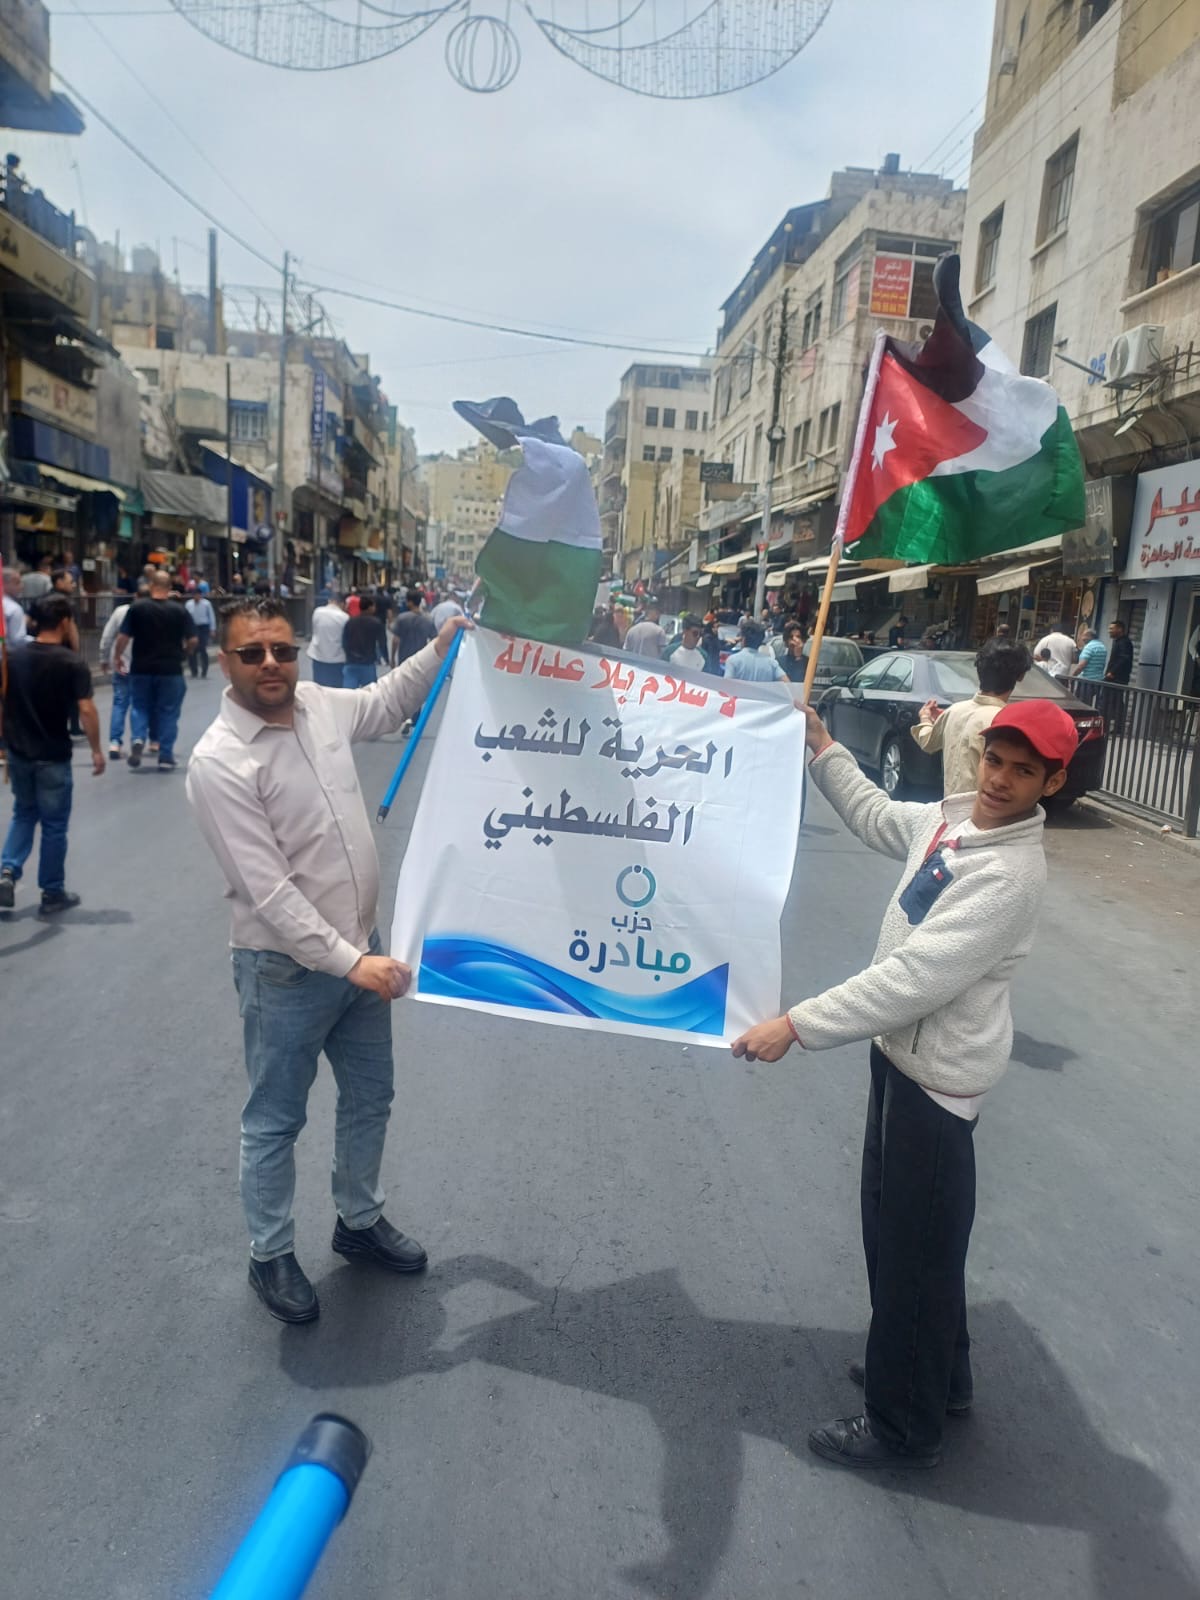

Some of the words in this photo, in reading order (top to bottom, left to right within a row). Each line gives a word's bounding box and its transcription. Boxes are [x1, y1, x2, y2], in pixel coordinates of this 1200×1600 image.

[493, 634, 586, 682] عدالة
[590, 658, 635, 705] بلا
[638, 675, 709, 707] سلام
[474, 707, 592, 763] للشعب
[599, 716, 733, 779] الحرية
[483, 787, 694, 850] الفلسطيني
[611, 911, 652, 934] حزب
[568, 929, 691, 982] مبادرة
